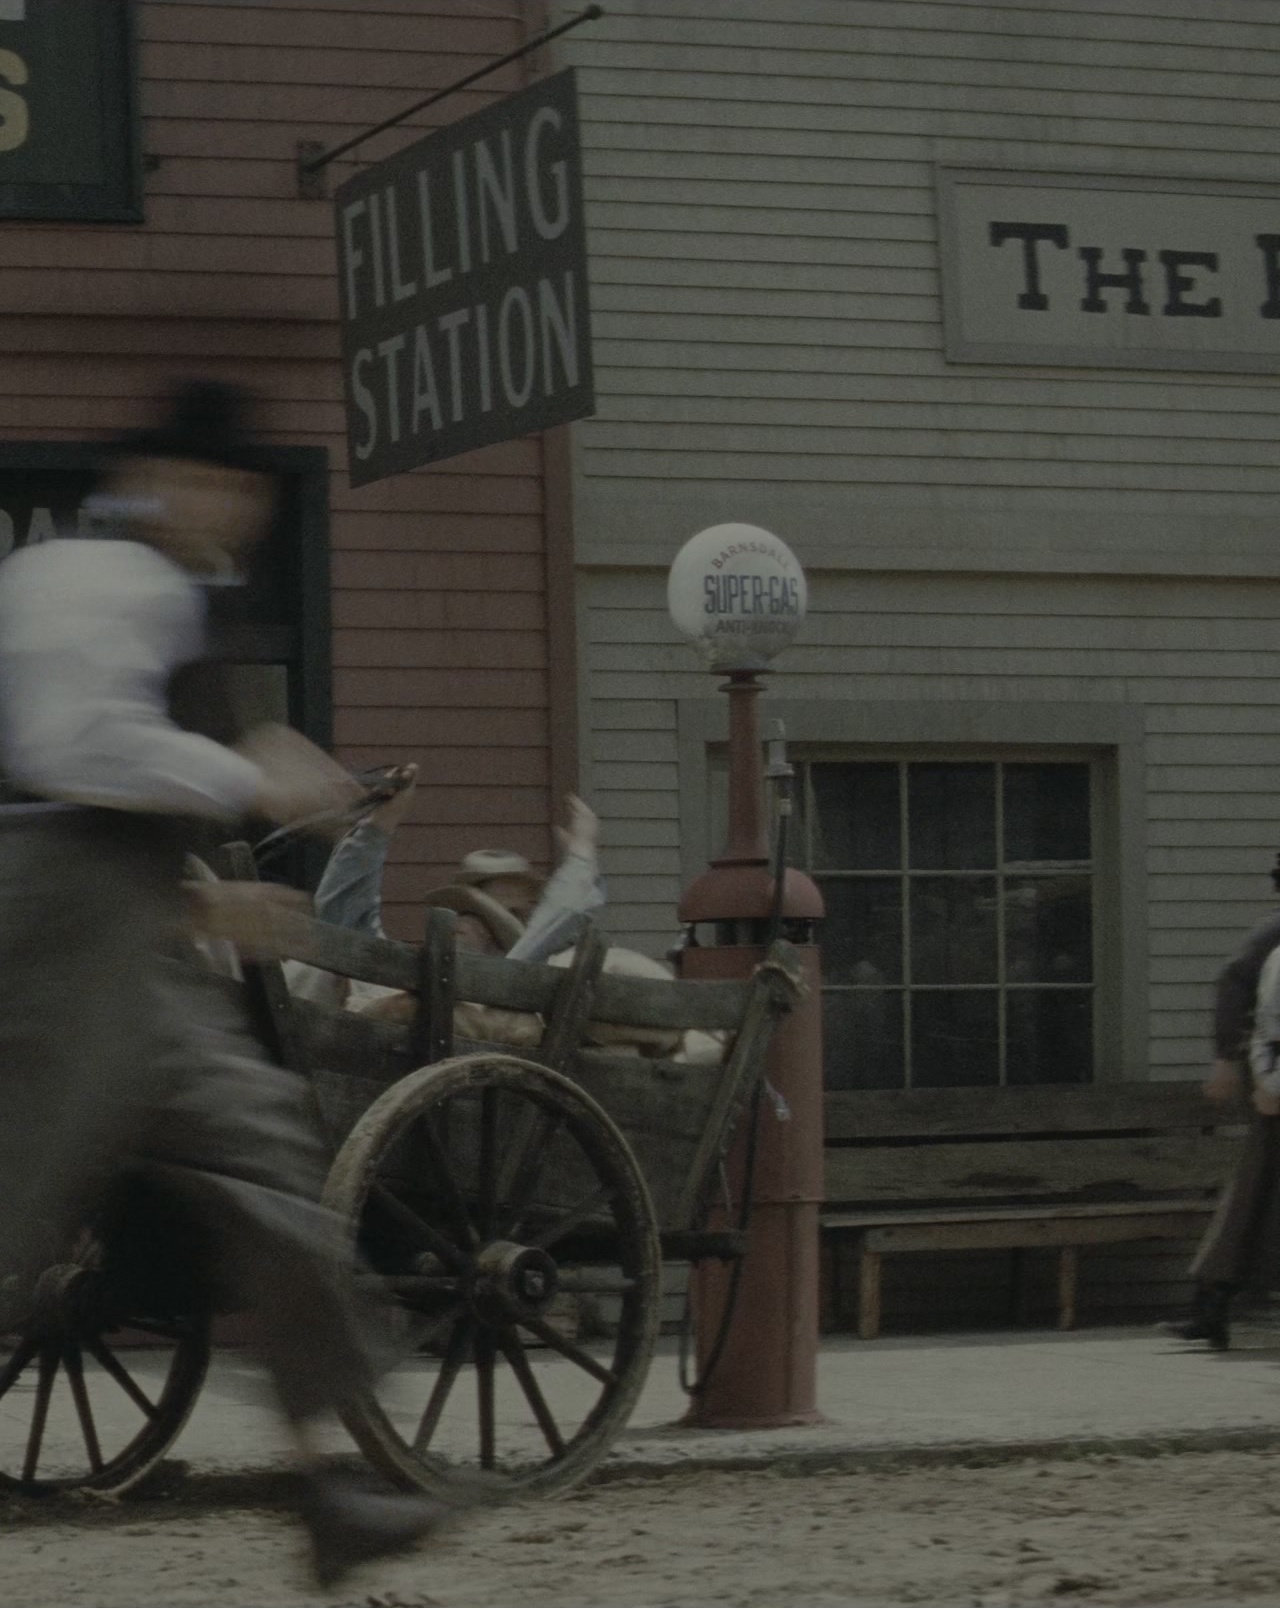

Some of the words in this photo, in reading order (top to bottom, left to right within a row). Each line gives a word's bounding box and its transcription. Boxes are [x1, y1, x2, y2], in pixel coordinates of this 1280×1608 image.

[342, 105, 572, 321] FILLING
[354, 271, 580, 461] STATION
[704, 574, 800, 616] SUPER-GAS
